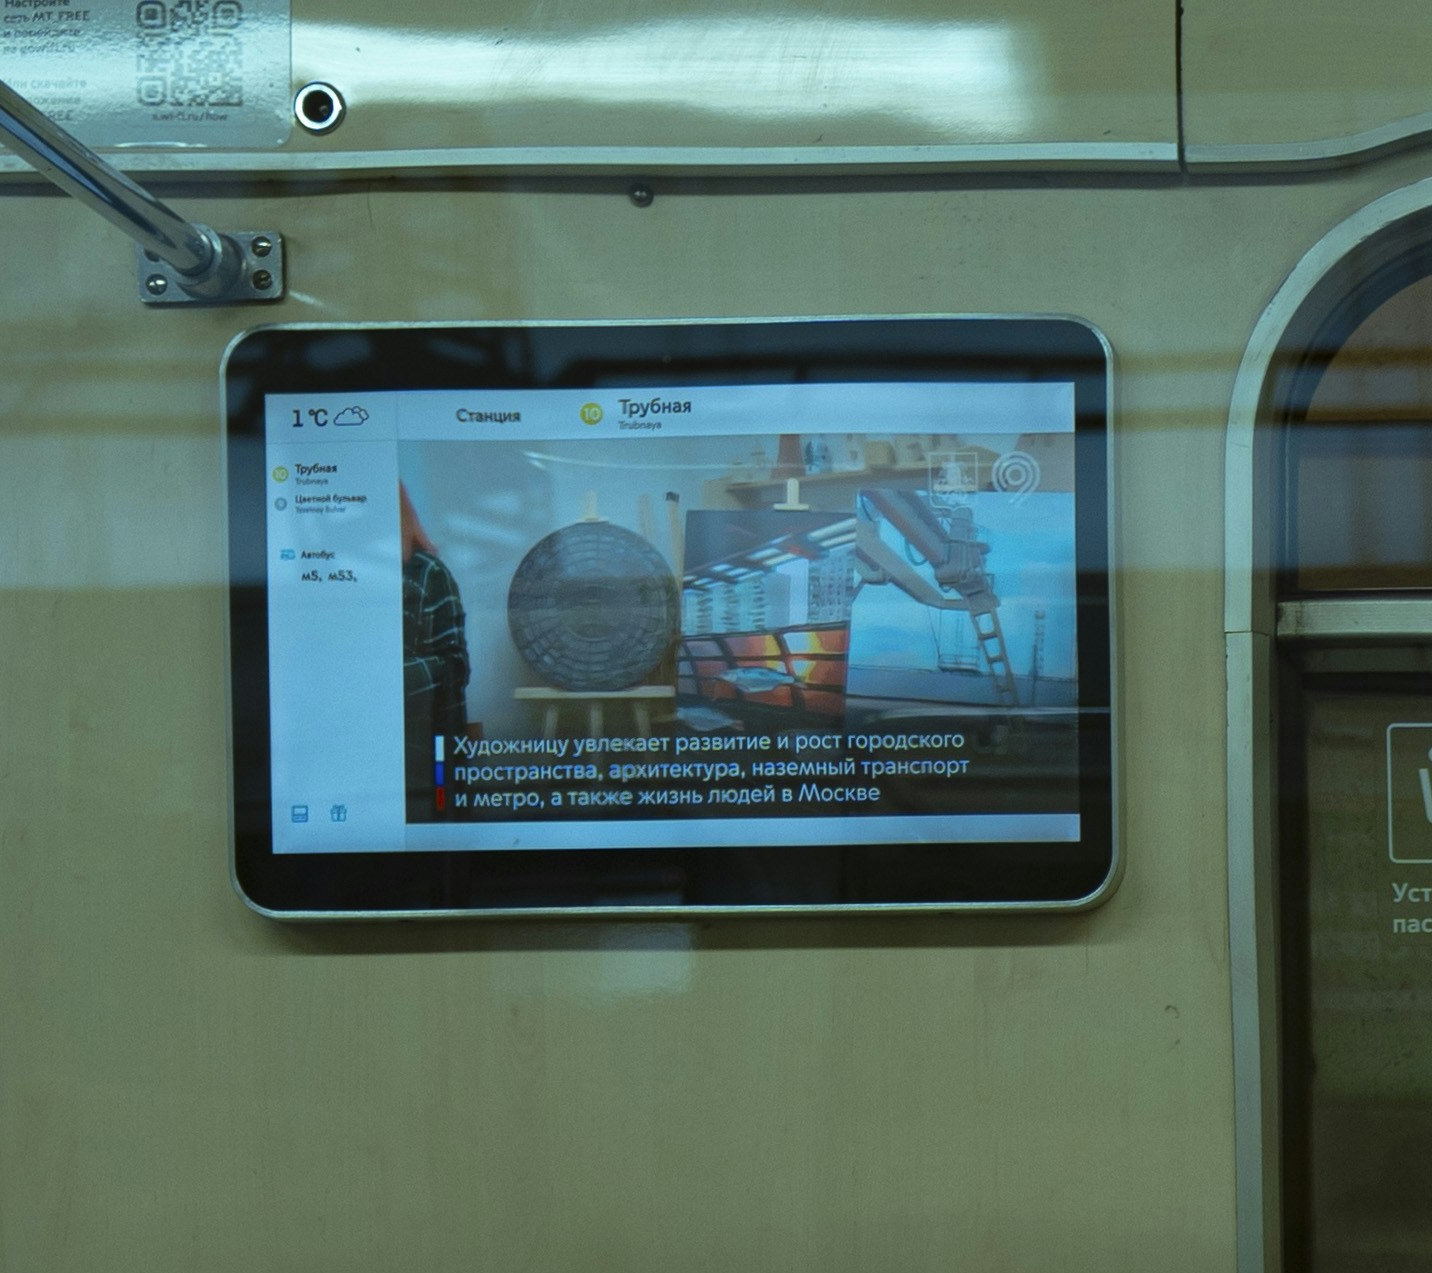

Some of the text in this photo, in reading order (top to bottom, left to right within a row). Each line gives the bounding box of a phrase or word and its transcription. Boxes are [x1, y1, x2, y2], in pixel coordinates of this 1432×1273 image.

[456, 408, 521, 424] Станция
[583, 407, 599, 421] 10
[619, 397, 692, 418] Трубная
[292, 409, 304, 427] 1
[295, 463, 338, 476] Трубная
[453, 733, 965, 758] Художницу увлекает развитие и рост городского
[454, 757, 970, 784] пространства, архитектура, наземный транспорт
[455, 783, 881, 810] и метро, а также жизнь людей в Москве
